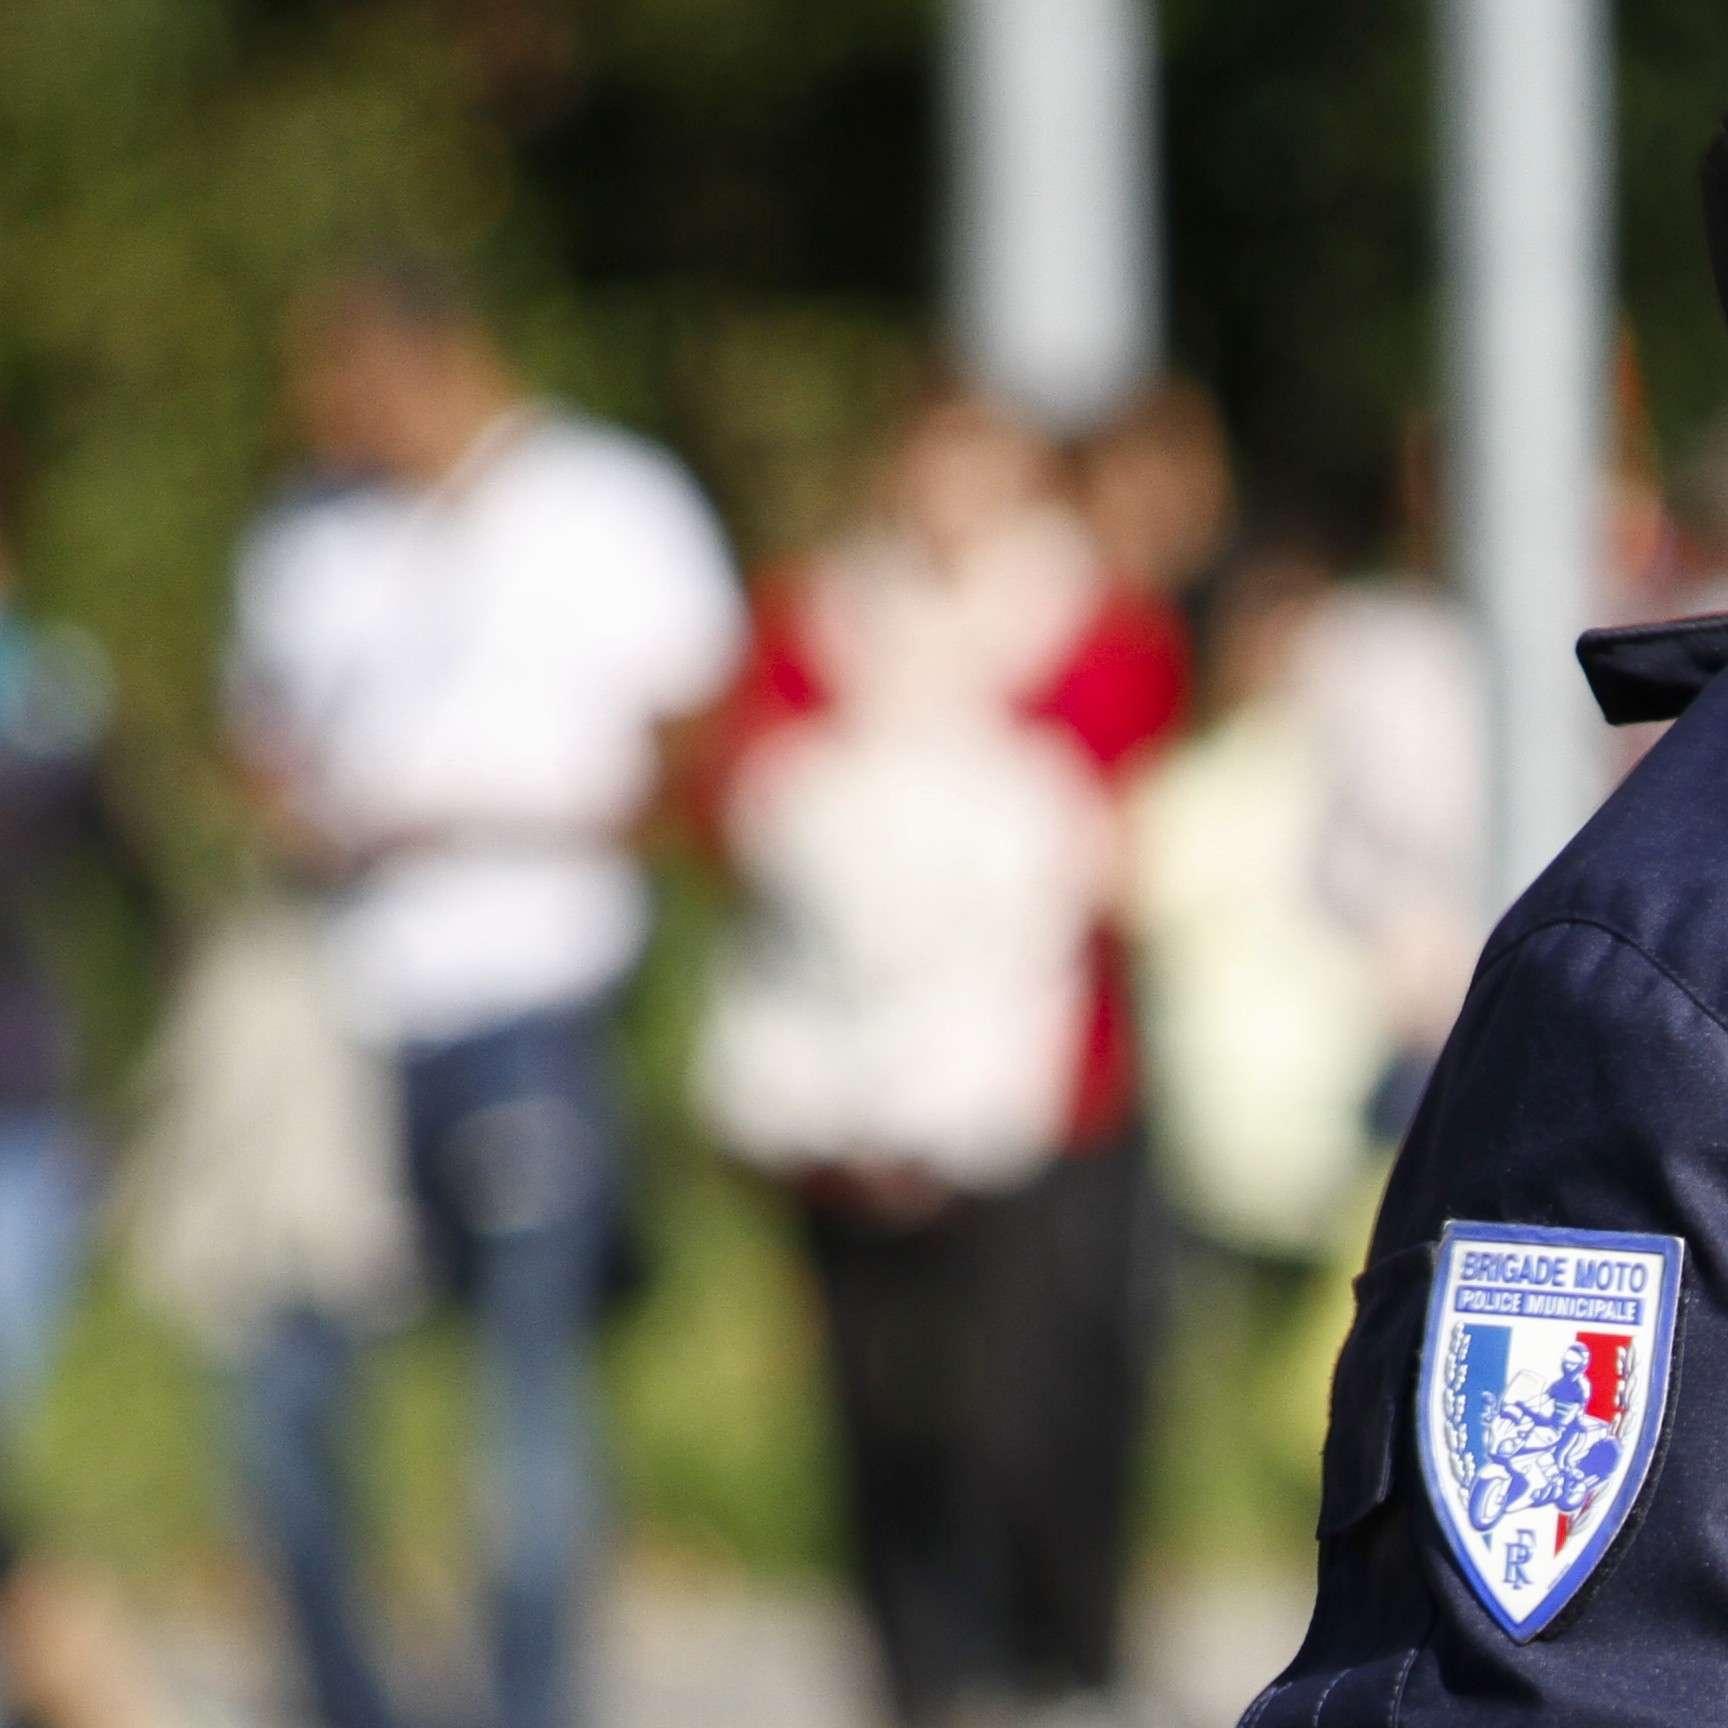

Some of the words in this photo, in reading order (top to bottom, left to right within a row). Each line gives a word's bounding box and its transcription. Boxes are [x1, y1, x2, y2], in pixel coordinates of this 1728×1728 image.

[1460, 1251, 1566, 1286] BRIGADE
[1574, 1258, 1647, 1292] MOTO
[1462, 1289, 1522, 1312] POLICE
[1527, 1293, 1637, 1320] MUNICIPALE
